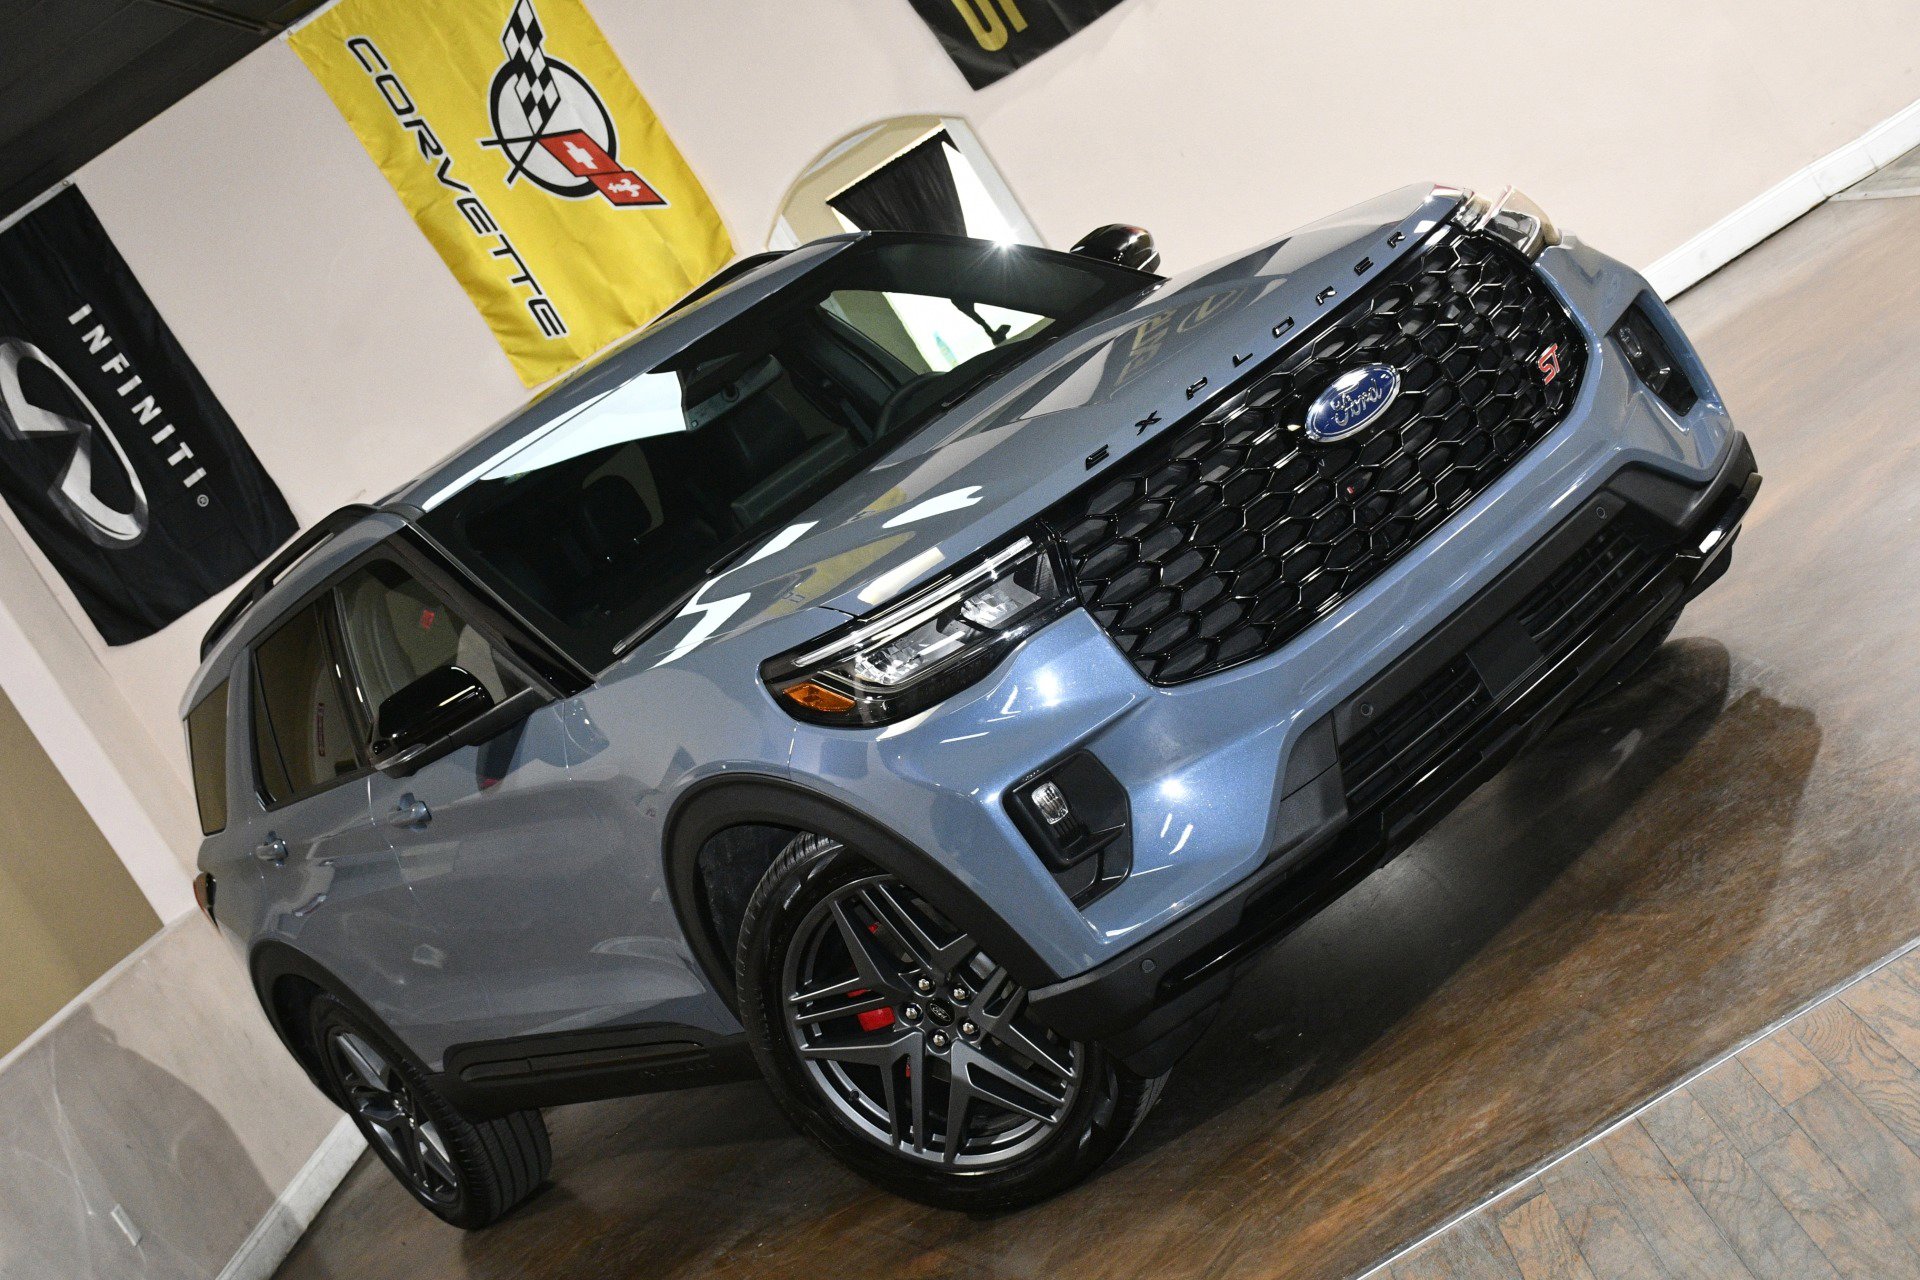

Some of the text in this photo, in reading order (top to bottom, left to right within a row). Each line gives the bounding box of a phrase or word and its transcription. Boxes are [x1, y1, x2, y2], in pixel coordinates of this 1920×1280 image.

[346, 36, 569, 339] CORVETTE
[68, 304, 207, 488] INFINITI
[1085, 231, 1407, 471] EXPLORER
[1329, 378, 1383, 427] Ford
[1537, 343, 1560, 386] ST
